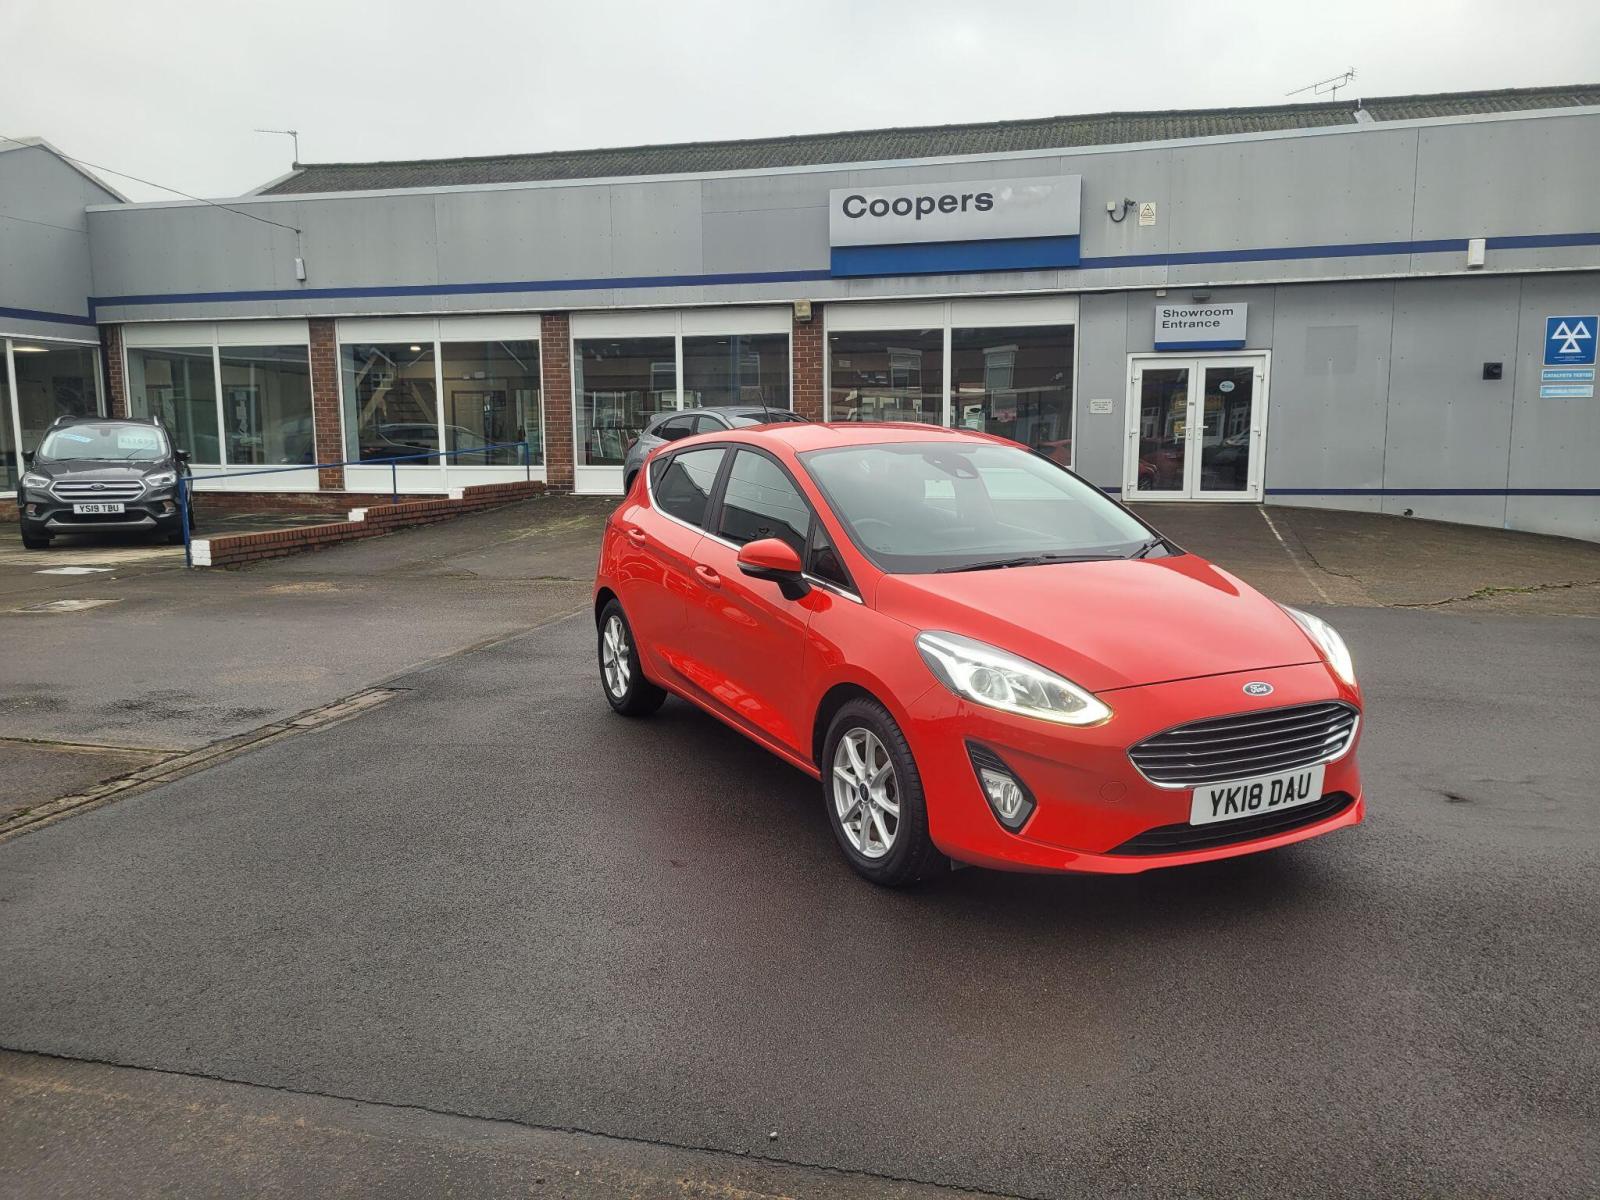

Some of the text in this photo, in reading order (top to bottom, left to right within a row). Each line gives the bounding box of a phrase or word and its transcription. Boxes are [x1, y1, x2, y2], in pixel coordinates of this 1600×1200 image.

[842, 192, 994, 220] Coopers
[1162, 308, 1234, 318] Showroom
[1162, 320, 1221, 329] Entrance
[1249, 684, 1268, 694] Ford
[1210, 772, 1312, 817] YK18 DAU
